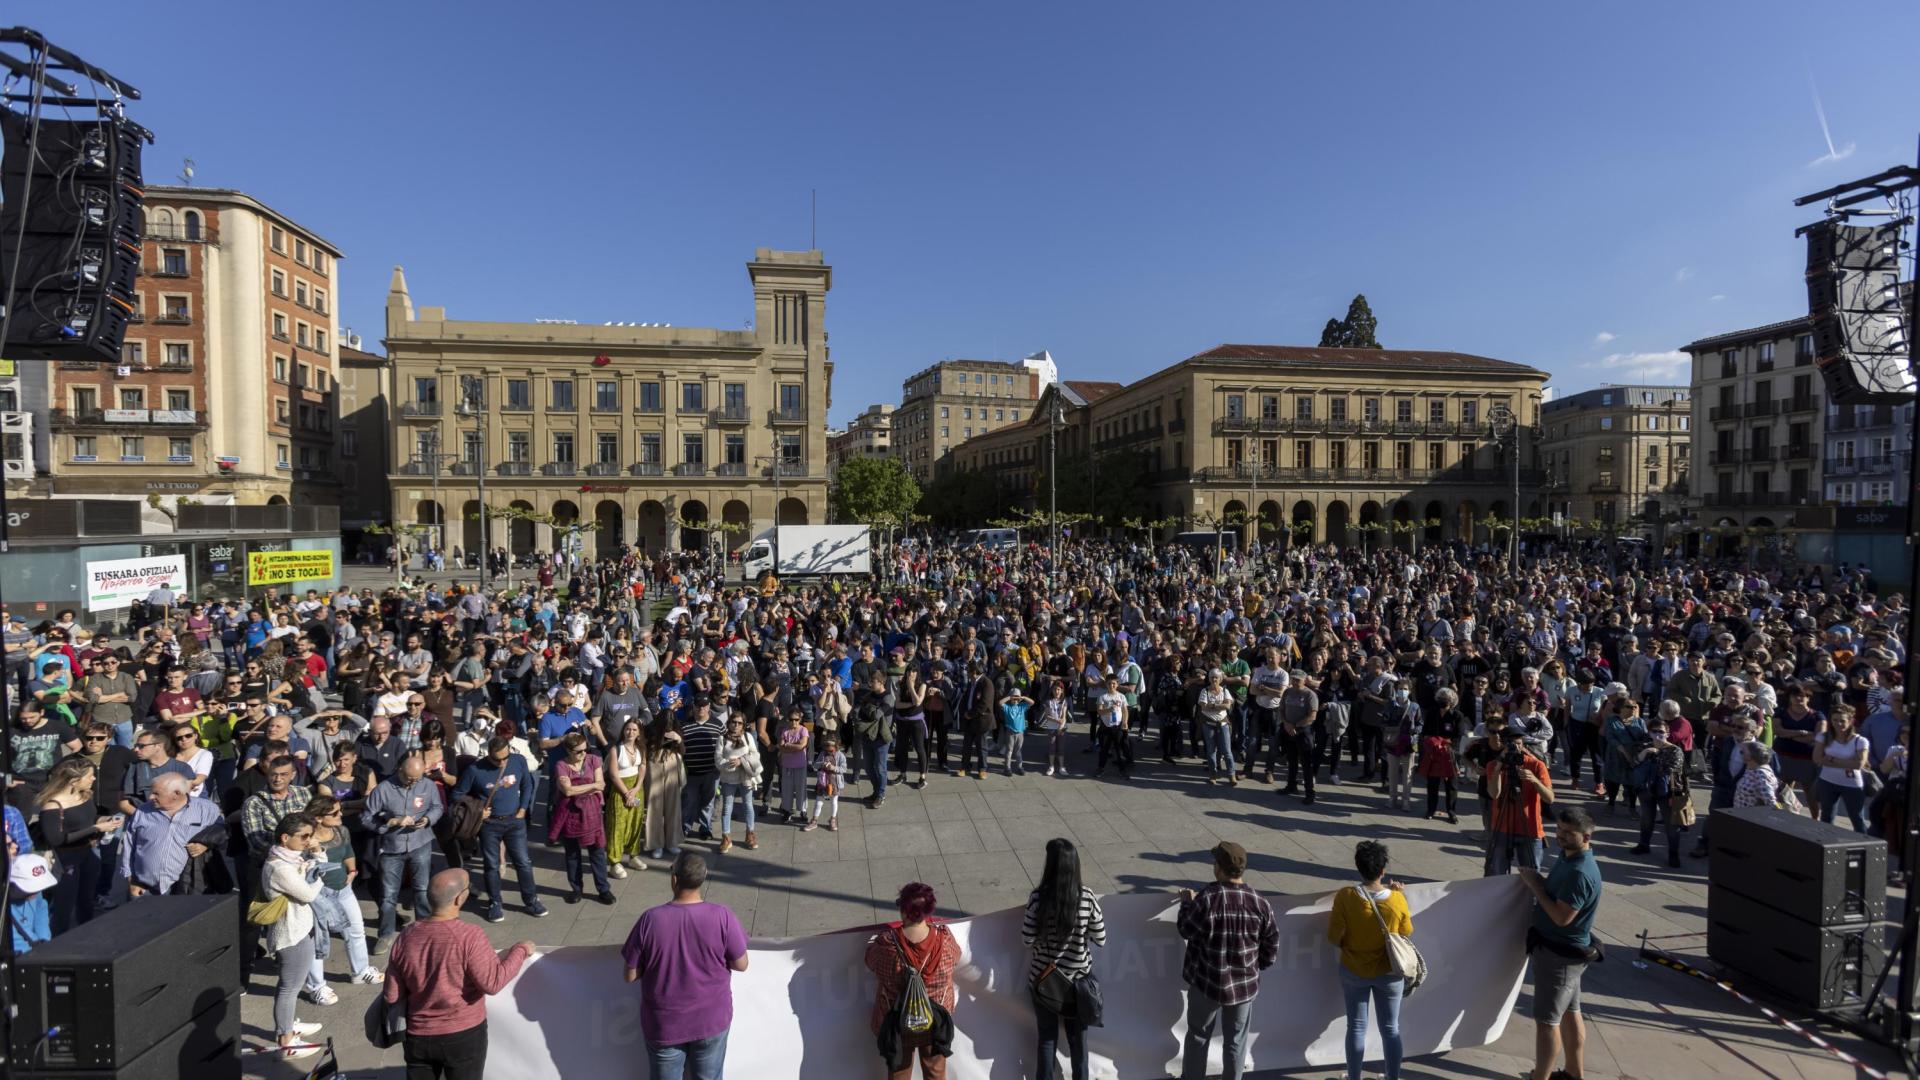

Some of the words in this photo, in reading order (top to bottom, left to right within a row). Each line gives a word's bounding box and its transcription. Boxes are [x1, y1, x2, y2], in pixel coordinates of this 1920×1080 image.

[95, 569, 138, 581] EUSKARA
[140, 565, 178, 577] OFIZIALA
[269, 569, 284, 579] ¡NO
[286, 569, 296, 578] SE
[298, 567, 320, 577] TOCA!
